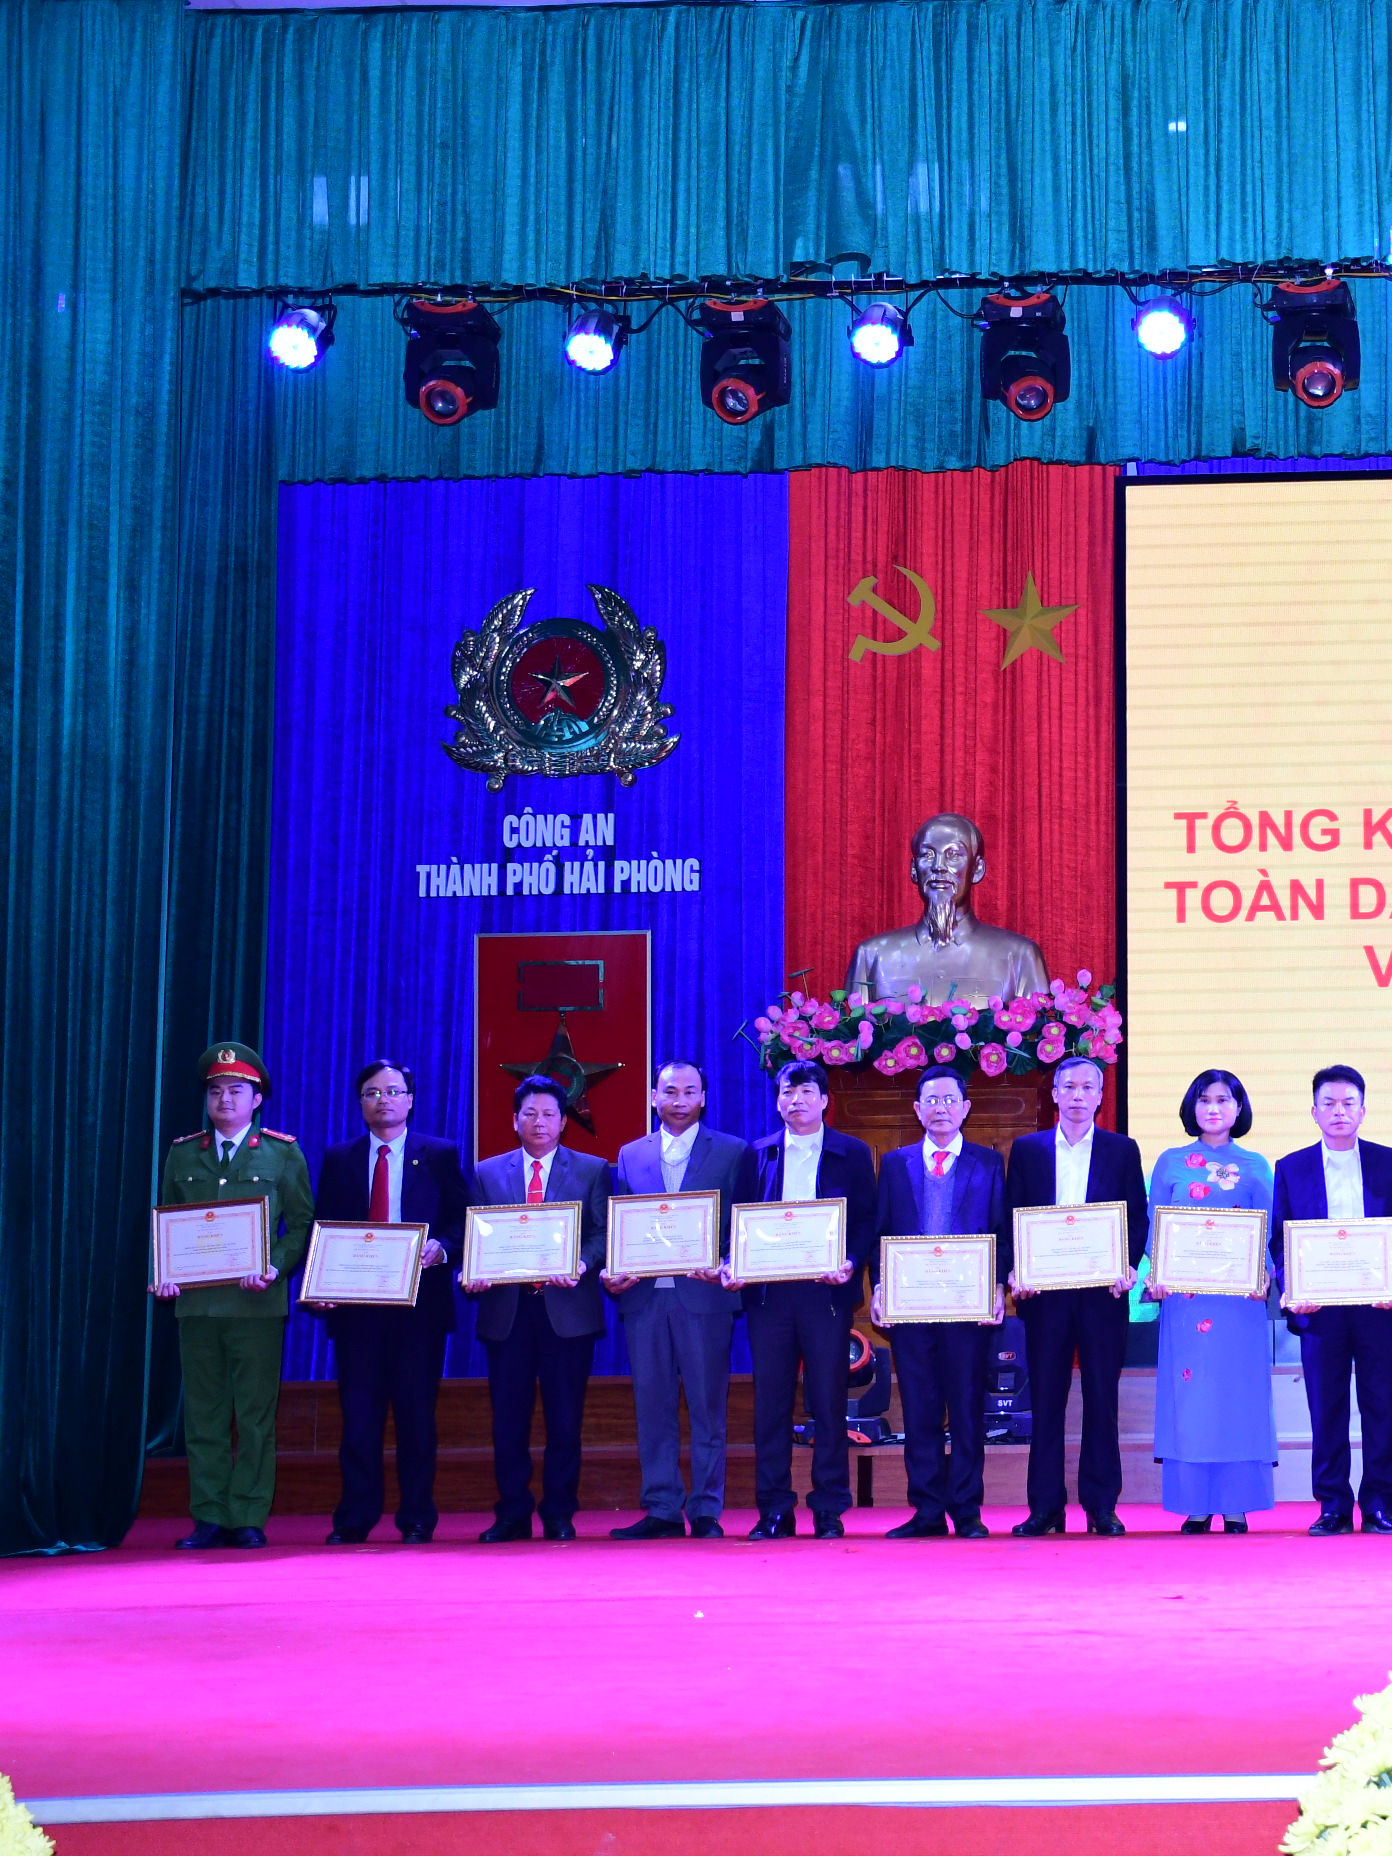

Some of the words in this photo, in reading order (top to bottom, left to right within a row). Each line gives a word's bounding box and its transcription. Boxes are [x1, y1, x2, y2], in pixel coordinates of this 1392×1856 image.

[502, 806, 571, 848] CÔNG
[578, 812, 615, 846] AN
[1173, 799, 1341, 855] TỔNG
[416, 856, 498, 897] THÀNH
[506, 849, 558, 896] PHỐ
[563, 848, 606, 895] HẢI
[613, 851, 700, 893] PHÒNG
[1164, 868, 1325, 923] TOÀN
[997, 1399, 1013, 1407] SVT
